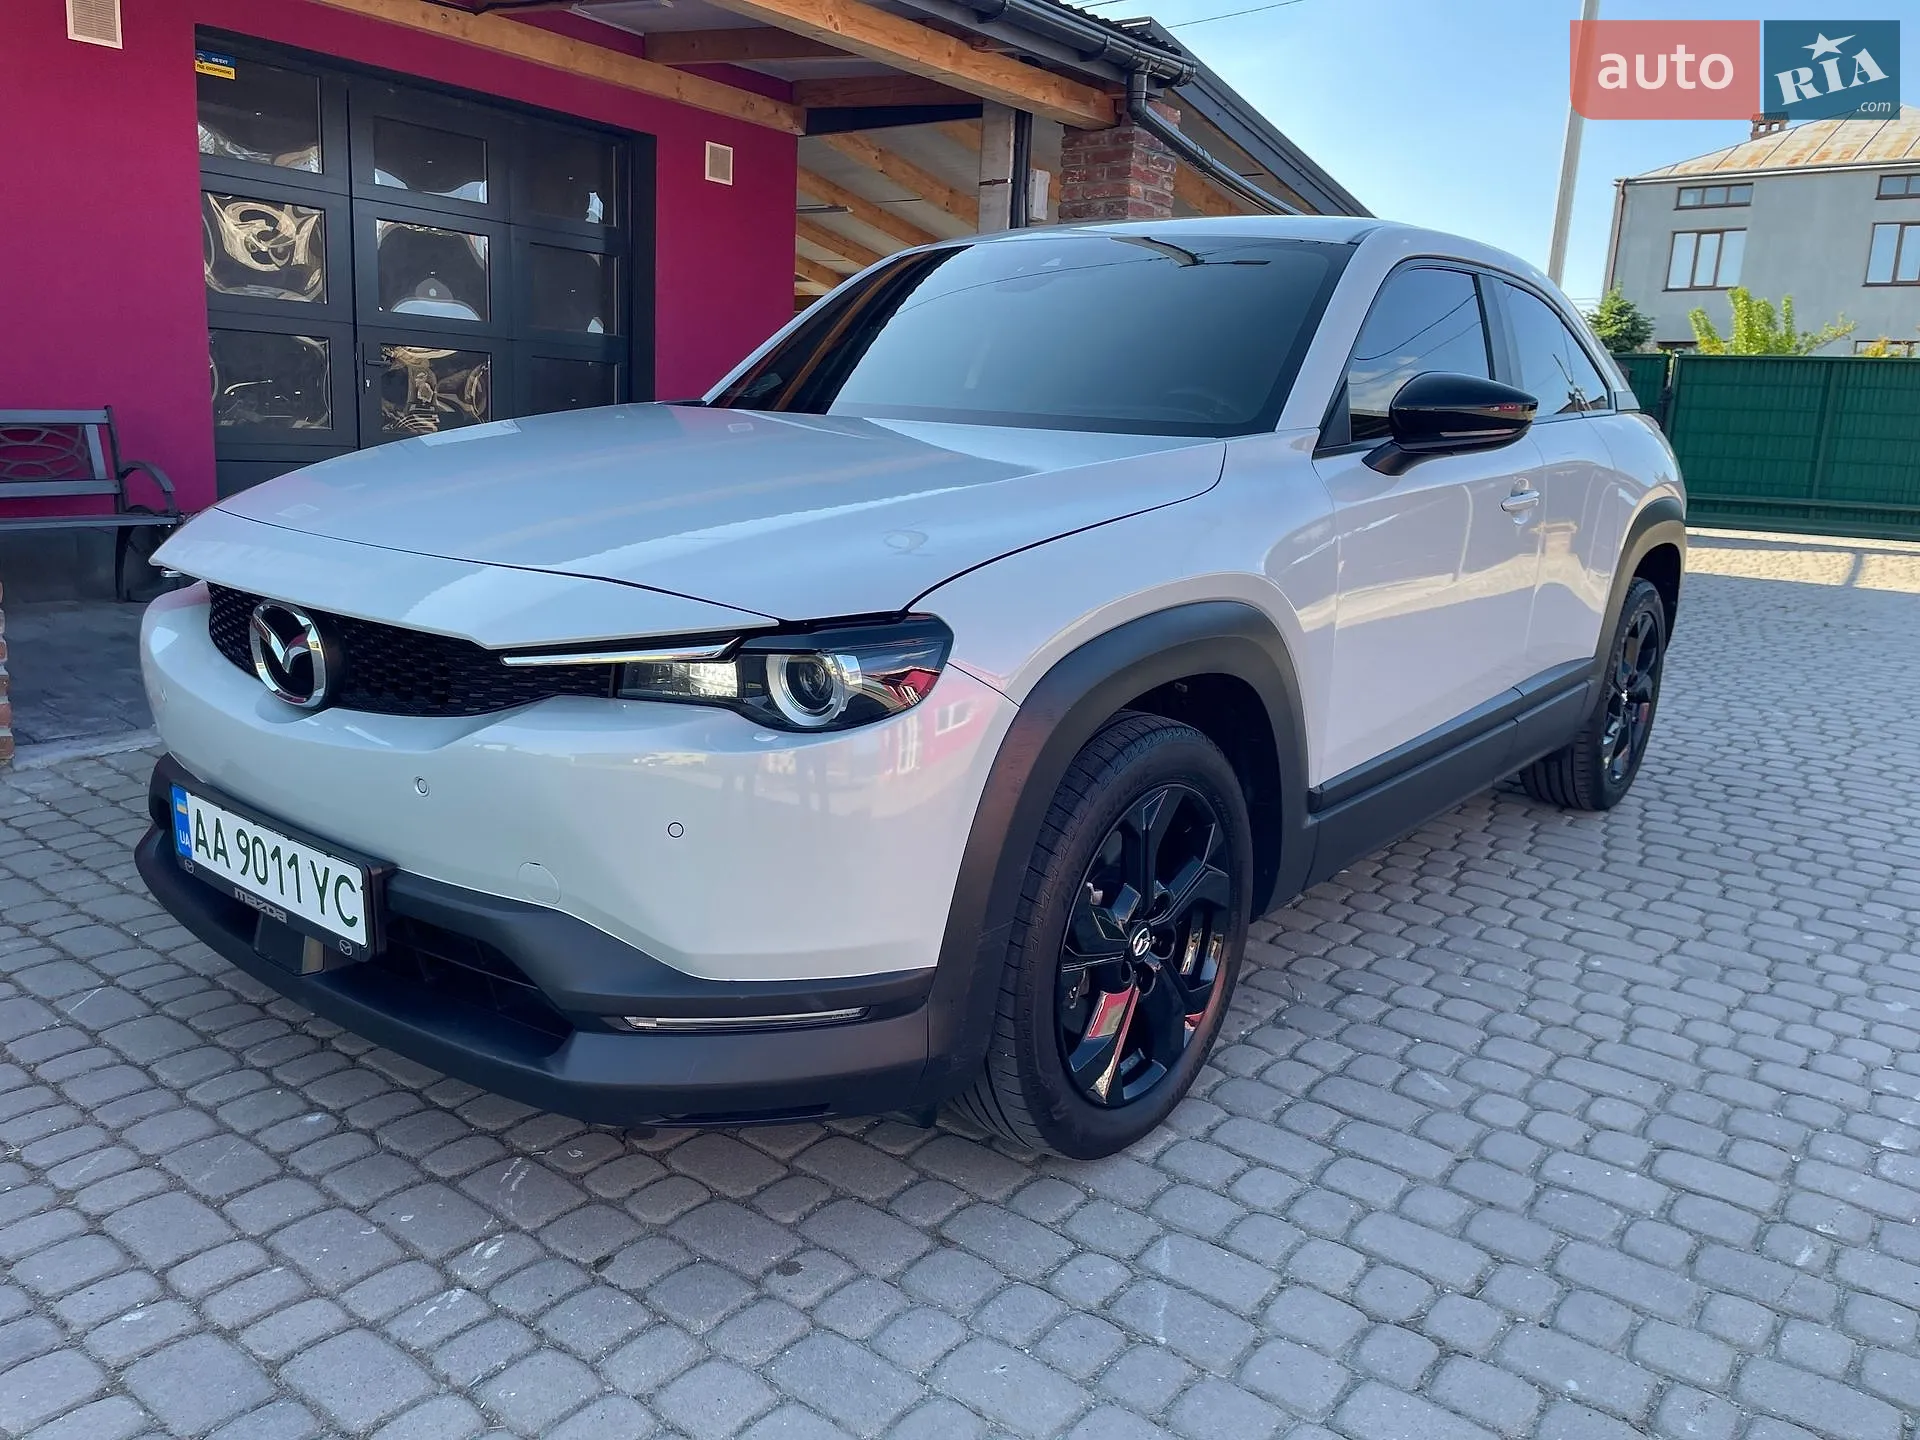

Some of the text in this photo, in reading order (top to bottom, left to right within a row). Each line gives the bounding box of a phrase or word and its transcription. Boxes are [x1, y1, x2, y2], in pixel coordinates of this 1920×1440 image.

[179, 831, 191, 848] UA
[195, 808, 358, 928] AA 9011 YC
[233, 886, 288, 924] mazda
